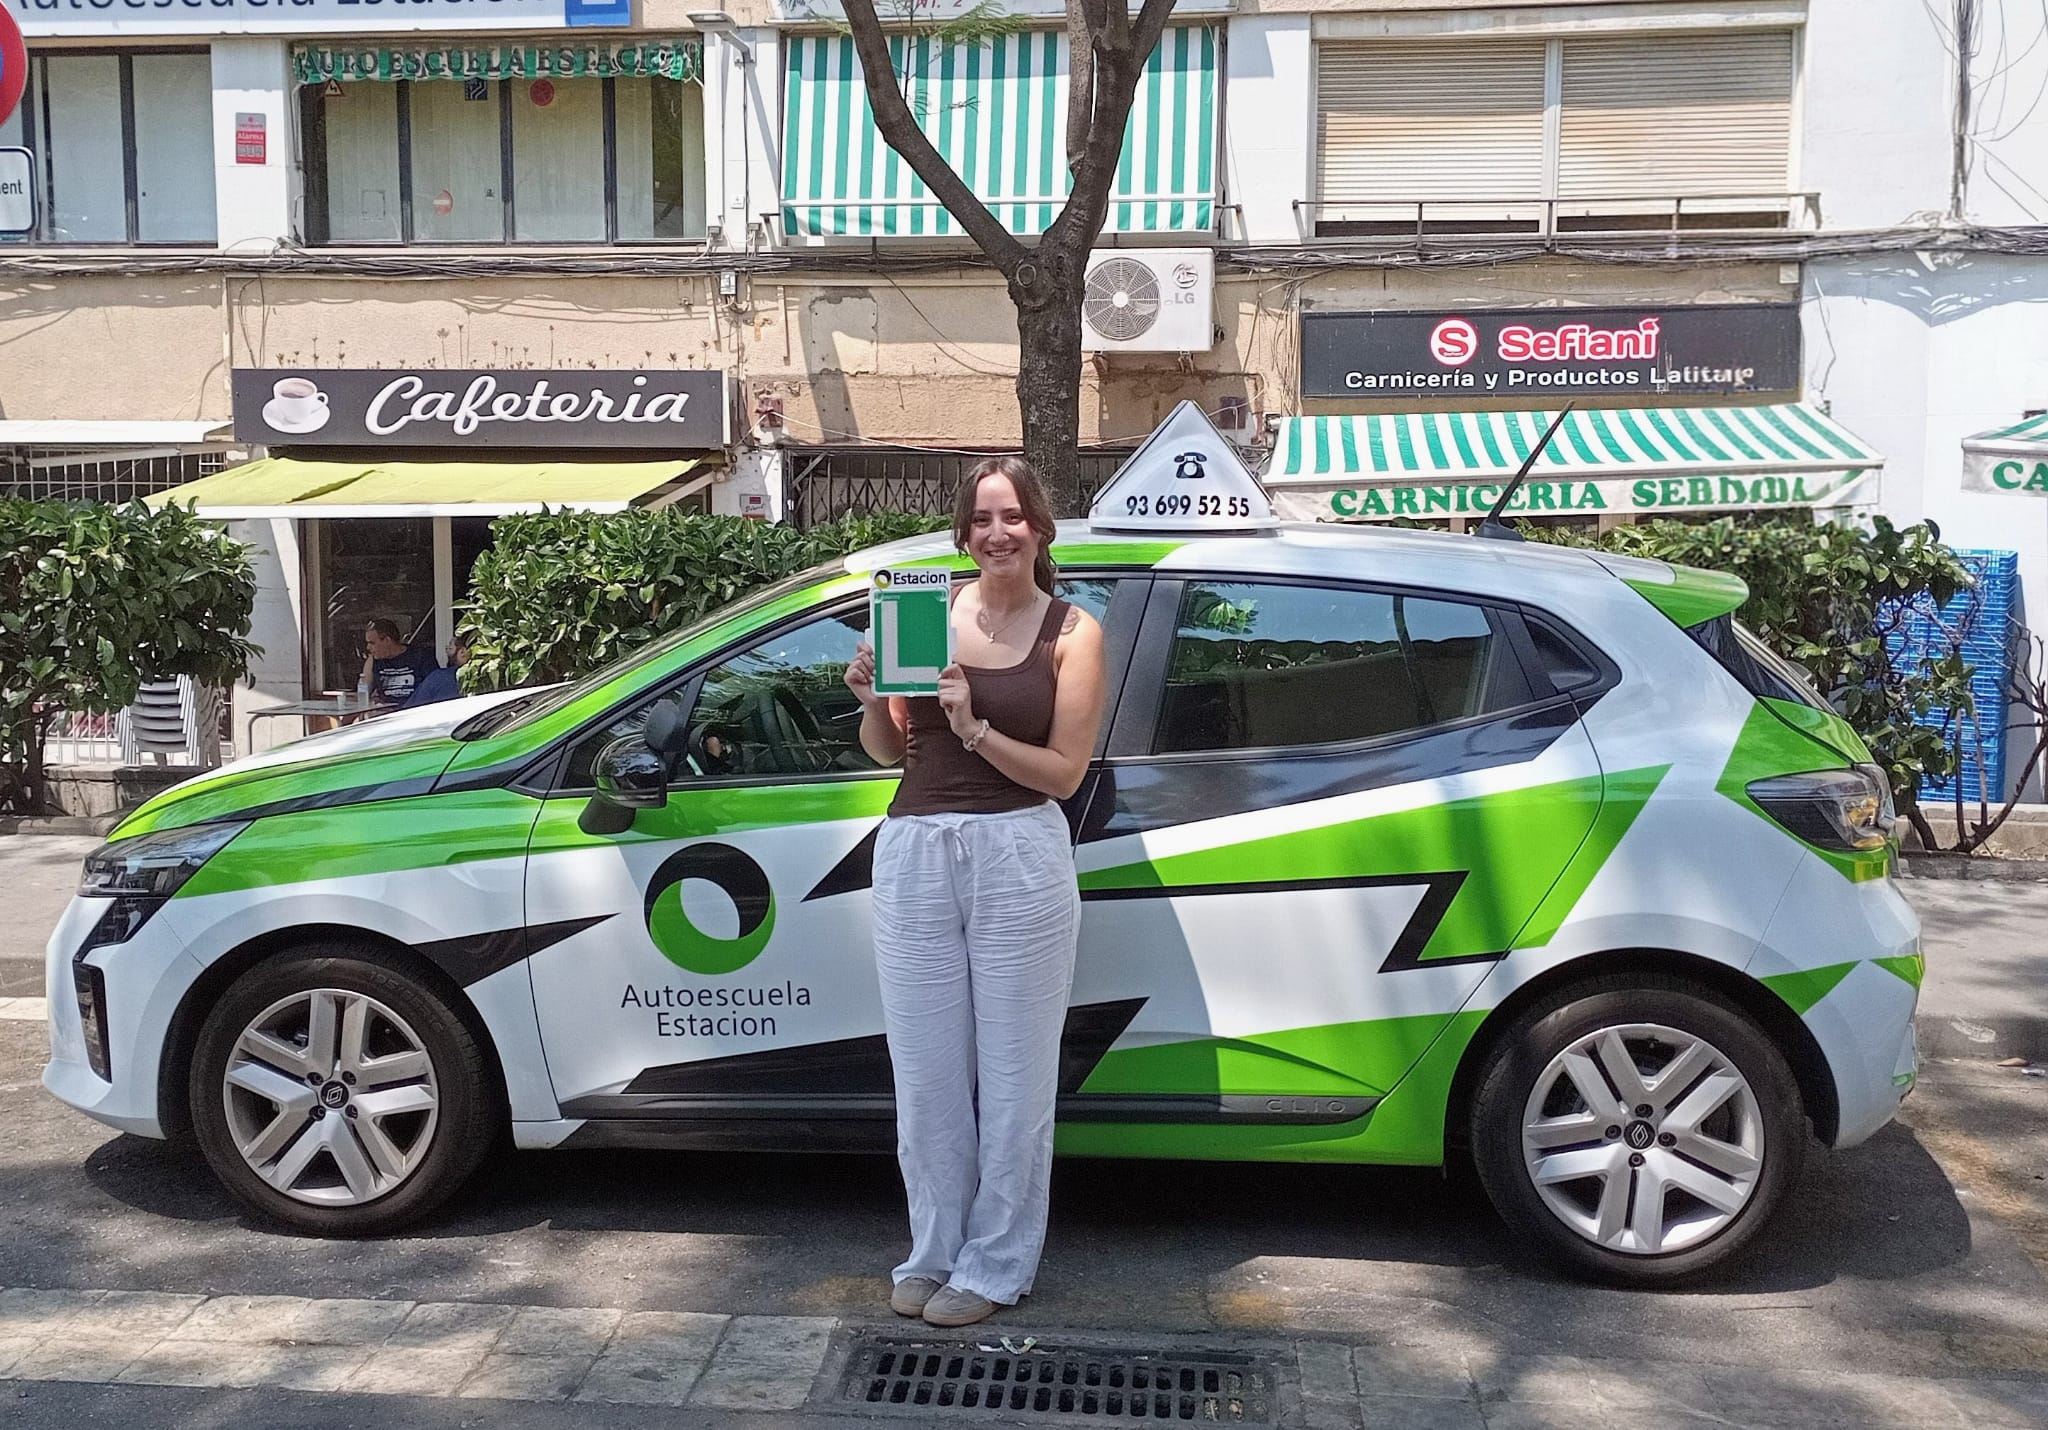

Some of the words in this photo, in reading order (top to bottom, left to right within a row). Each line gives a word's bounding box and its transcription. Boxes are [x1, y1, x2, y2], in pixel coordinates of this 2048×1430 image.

[1174, 292, 1195, 304] LG
[1345, 369, 1475, 388] Carnicería
[1484, 372, 1499, 389] y
[1508, 367, 1640, 386] Productos
[365, 375, 690, 436] Cafeteria
[1126, 495, 1149, 516] 93
[1155, 494, 1191, 516] 699
[1198, 495, 1221, 516] 52
[1228, 496, 1250, 517] 55
[1331, 481, 1609, 516] CARNICERIA
[893, 571, 947, 585] Estacion
[881, 600, 940, 685] L
[621, 980, 811, 1008] Autoescuela
[657, 1010, 777, 1037] Estacion
[1264, 1098, 1346, 1113] CLIO
